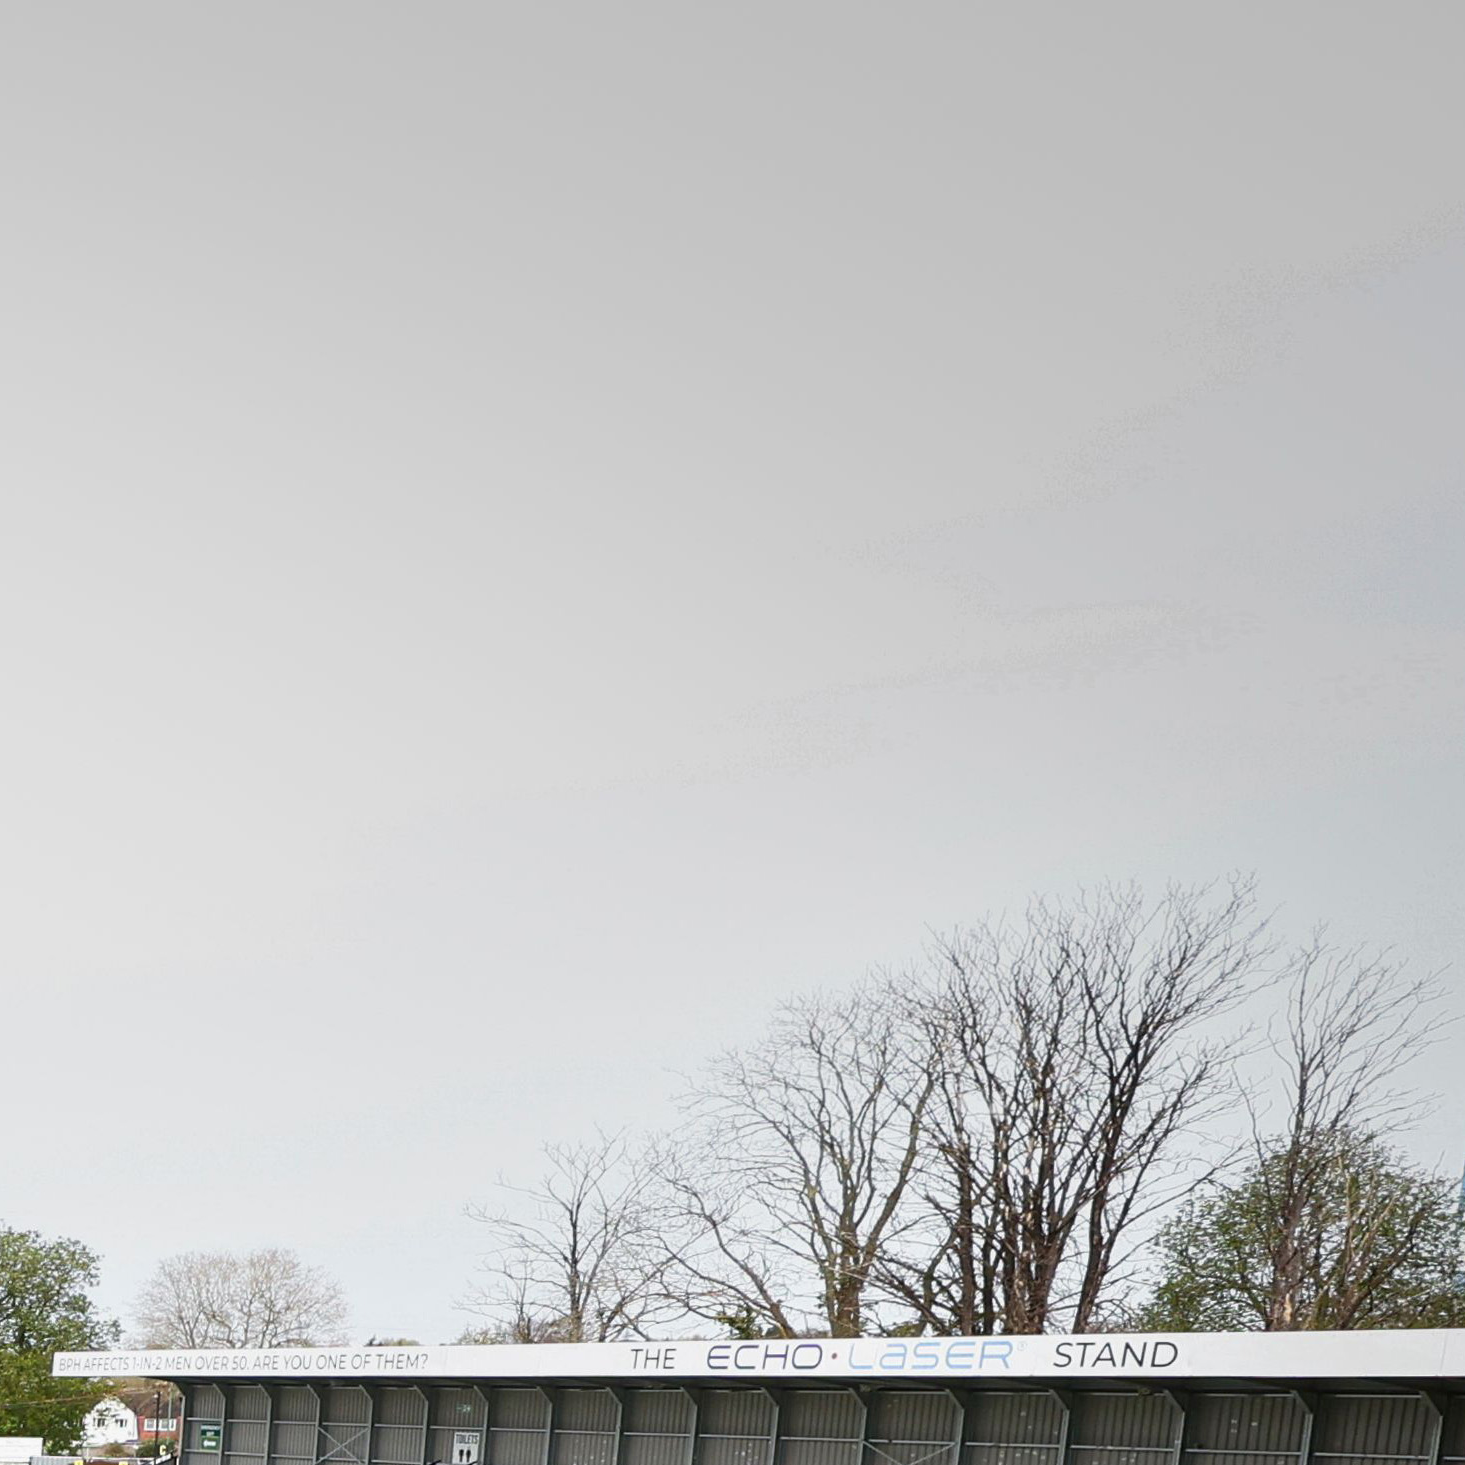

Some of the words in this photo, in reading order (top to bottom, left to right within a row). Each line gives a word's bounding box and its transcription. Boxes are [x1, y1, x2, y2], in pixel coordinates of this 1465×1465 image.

[59, 1356, 80, 1372] BPH
[84, 1356, 130, 1372] AFFECTS
[165, 1355, 192, 1370] MEN
[195, 1355, 229, 1371] OVER
[253, 1355, 280, 1371] ARE
[283, 1354, 311, 1371] YOU
[315, 1354, 347, 1370] ONE
[351, 1354, 371, 1370] OF
[375, 1354, 429, 1370] THEM?
[631, 1348, 676, 1369] THE
[707, 1344, 822, 1370] ECHO
[1054, 1341, 1178, 1368] STAND
[455, 1433, 480, 1444] TOILETS
